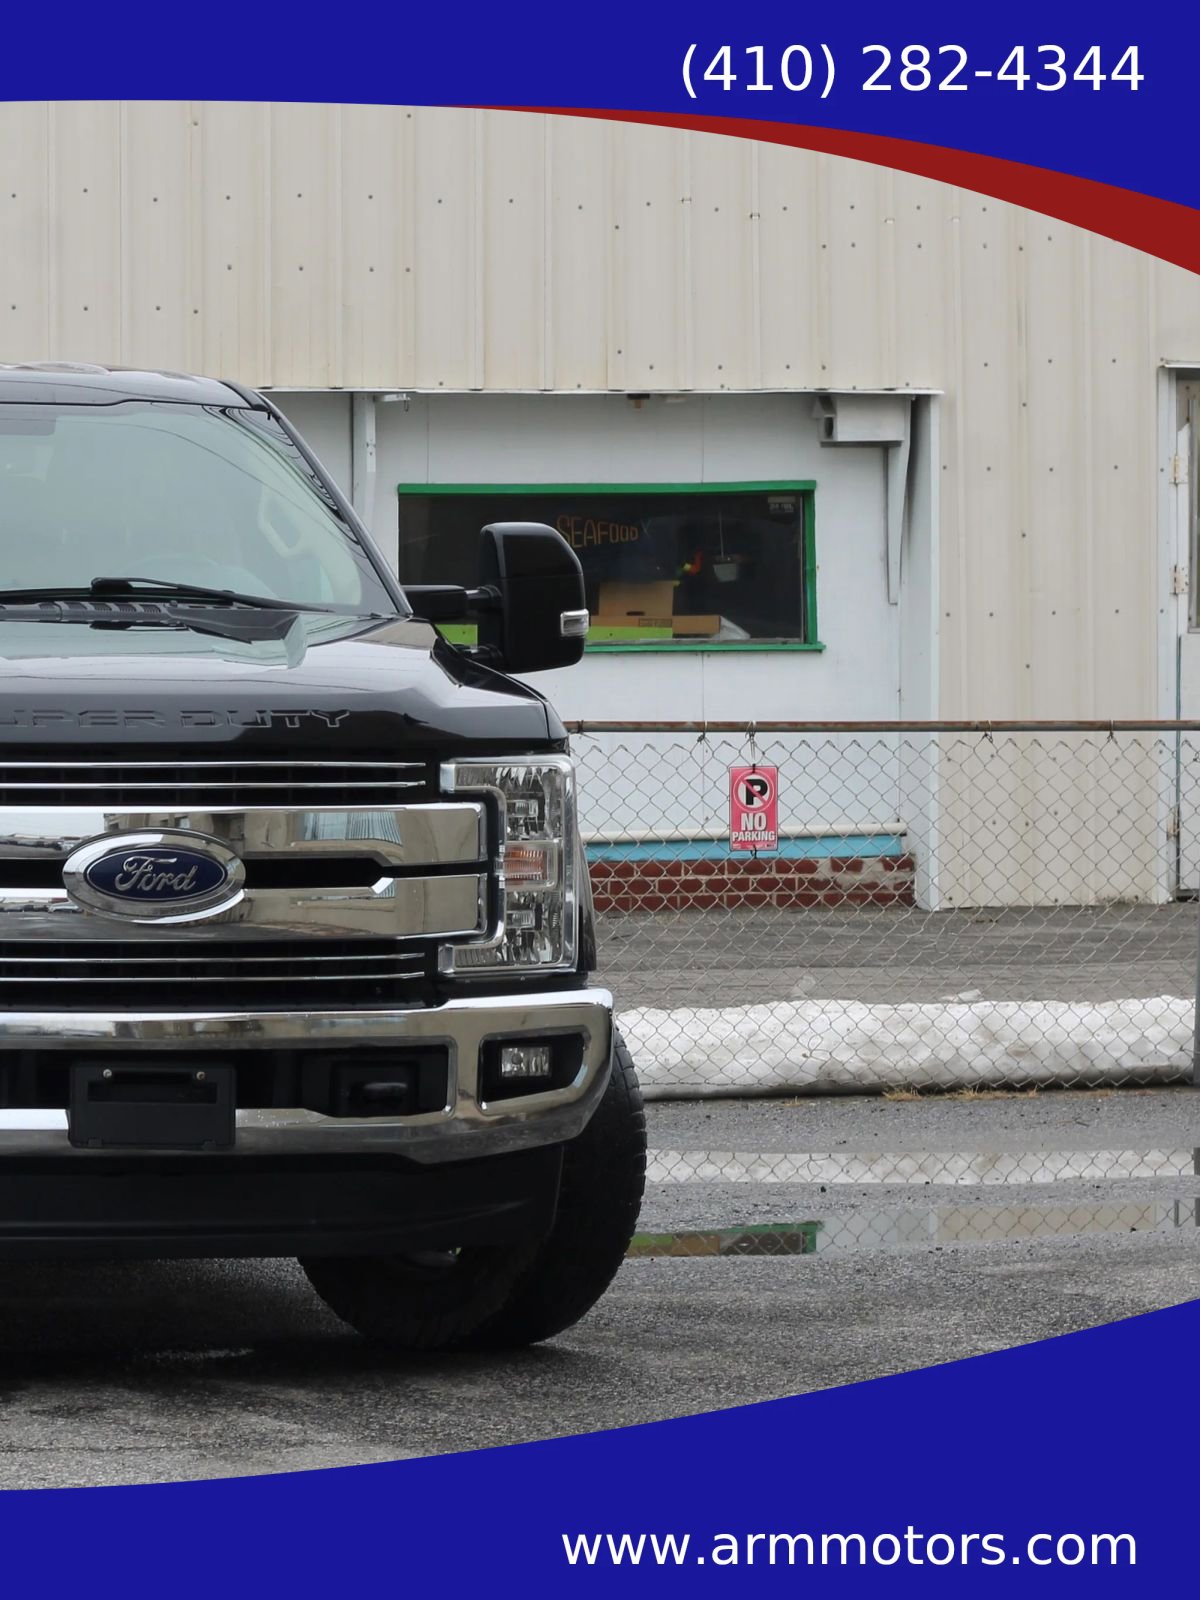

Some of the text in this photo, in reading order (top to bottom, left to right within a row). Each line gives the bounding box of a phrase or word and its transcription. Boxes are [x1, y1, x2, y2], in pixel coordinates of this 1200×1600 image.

[555, 513, 640, 549] SEAFOOD
[179, 708, 351, 729] DUTY
[740, 812, 768, 831] NO
[732, 831, 776, 842] PARKING
[114, 855, 199, 892] Ford
